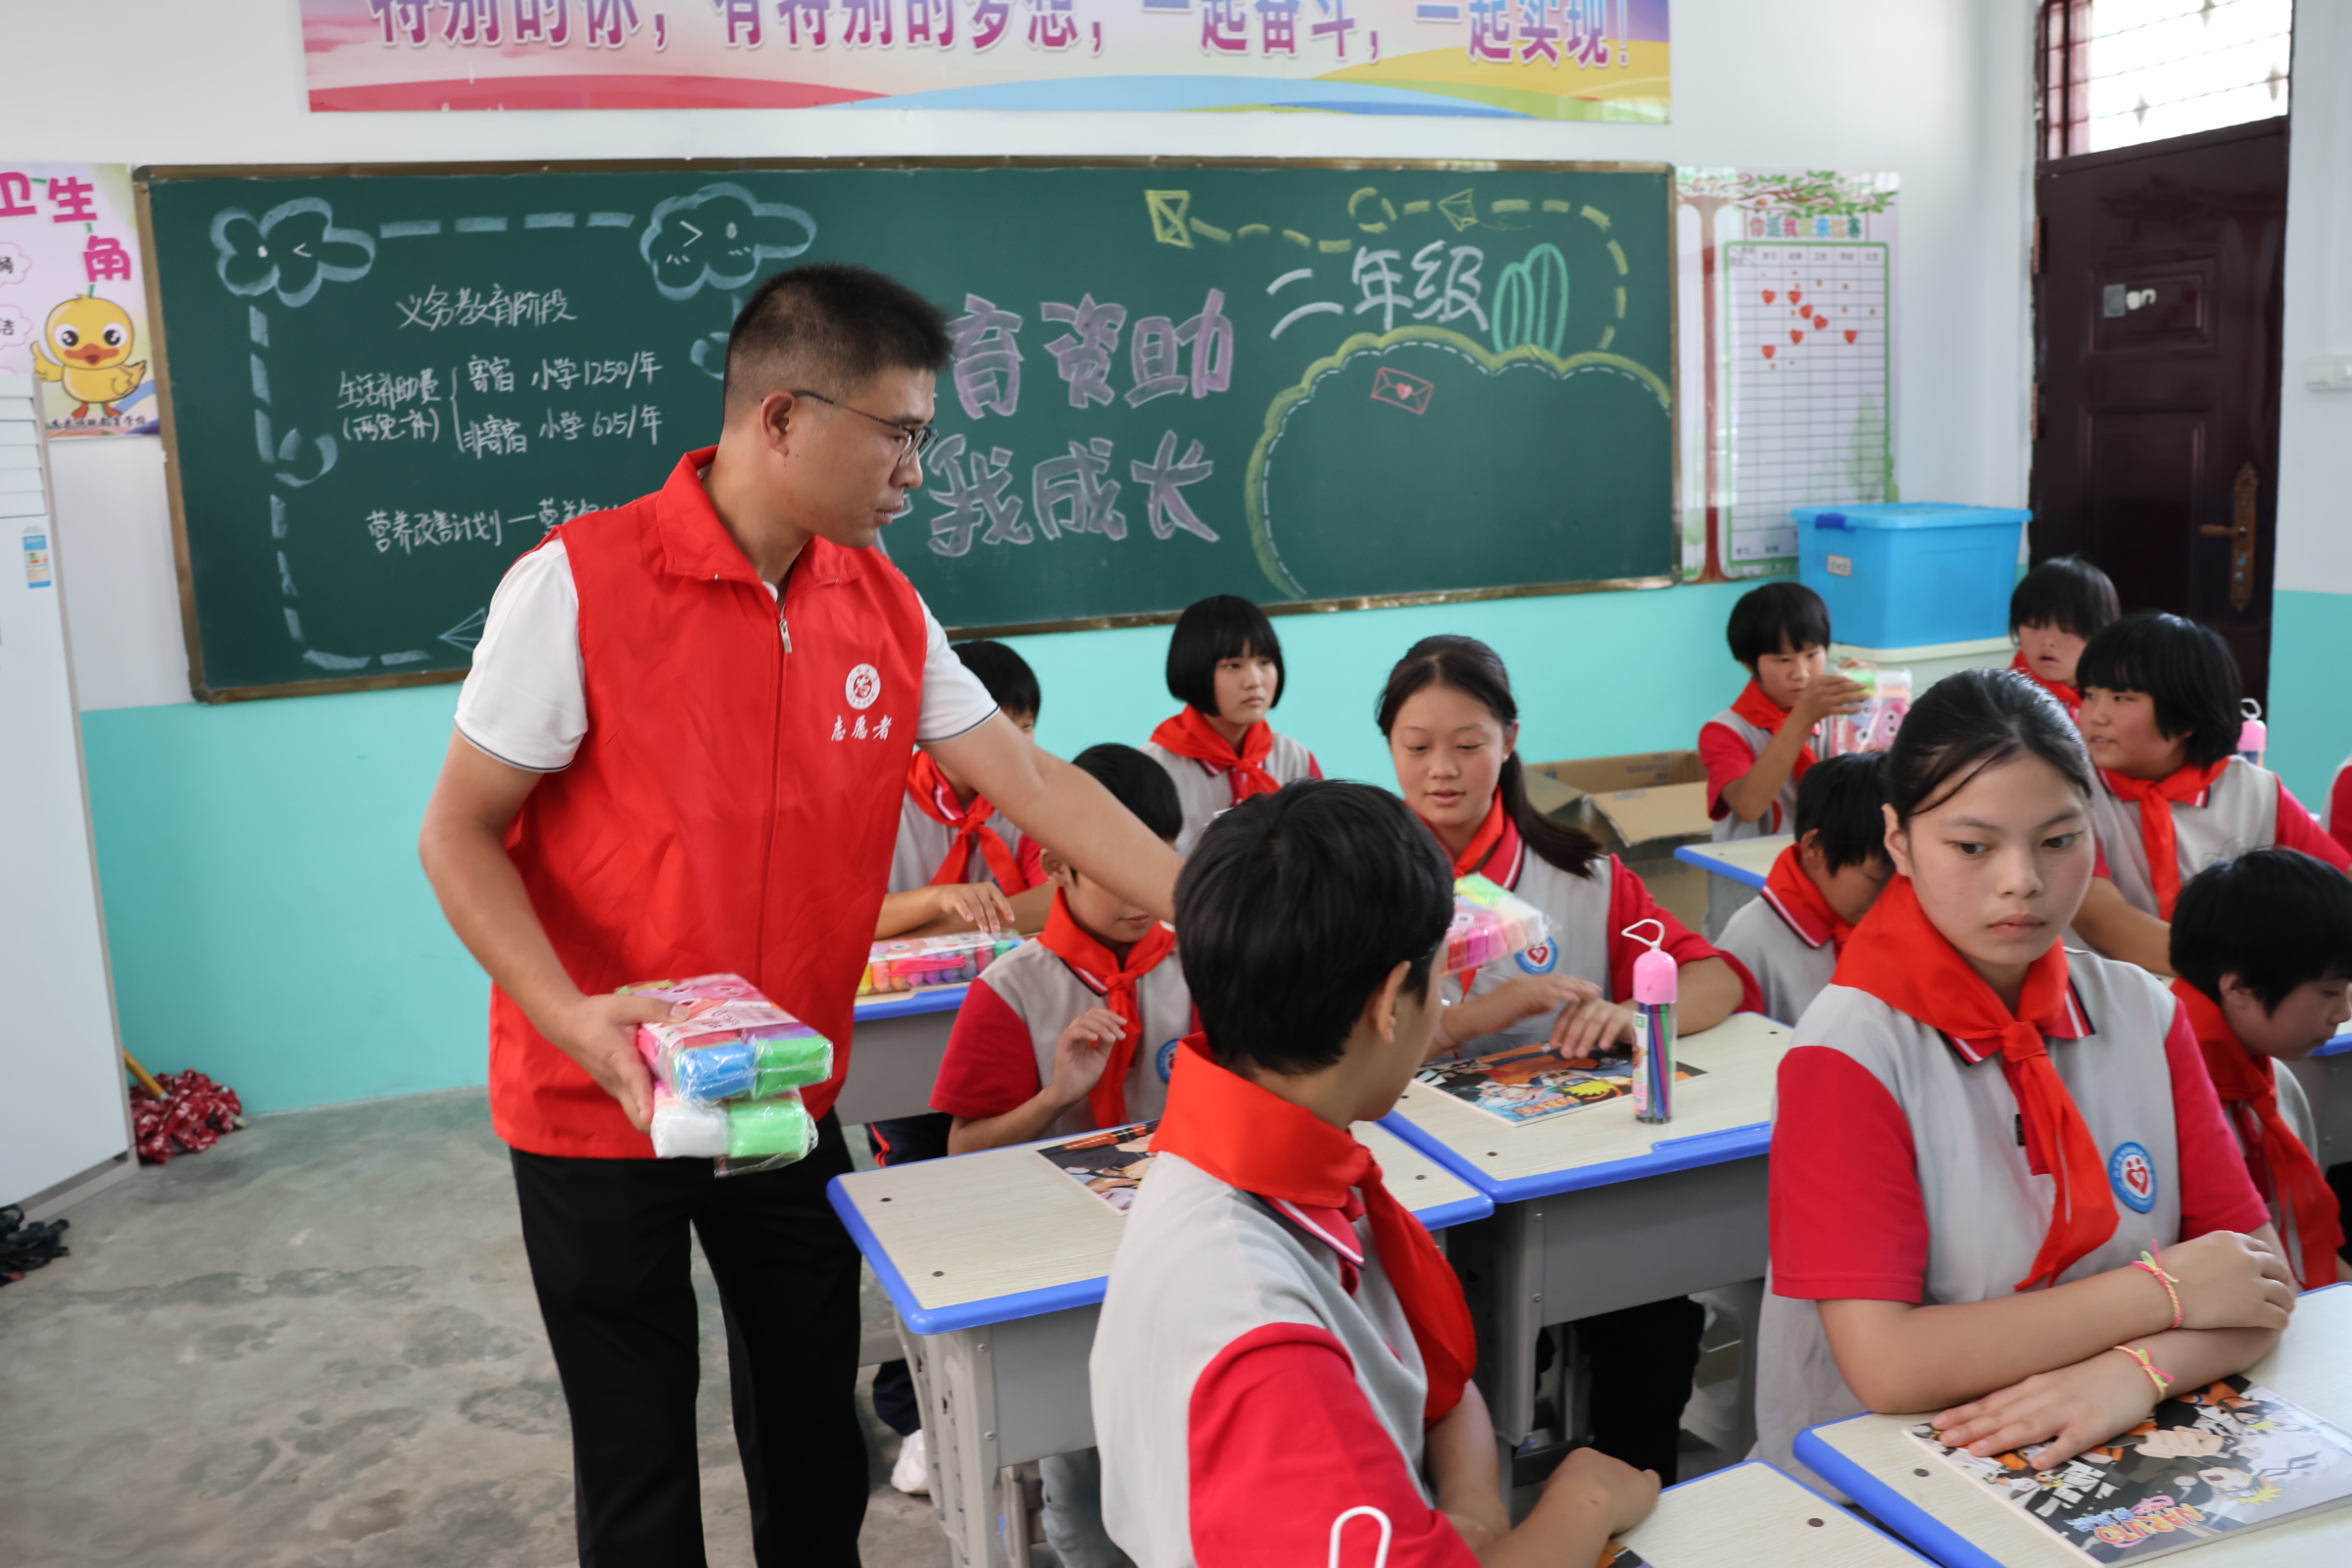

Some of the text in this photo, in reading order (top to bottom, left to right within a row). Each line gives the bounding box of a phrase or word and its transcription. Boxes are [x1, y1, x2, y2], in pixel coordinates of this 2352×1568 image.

[396, 284, 578, 331] 义务教育阶段
[1267, 240, 1489, 338] 二年级
[531, 358, 581, 390] 小学
[933, 288, 1233, 419] 育资助
[539, 408, 585, 441] 小学
[900, 429, 1219, 558] 我成长
[831, 714, 892, 742] 志愿者
[2095, 1503, 2206, 1544] NARUTO
